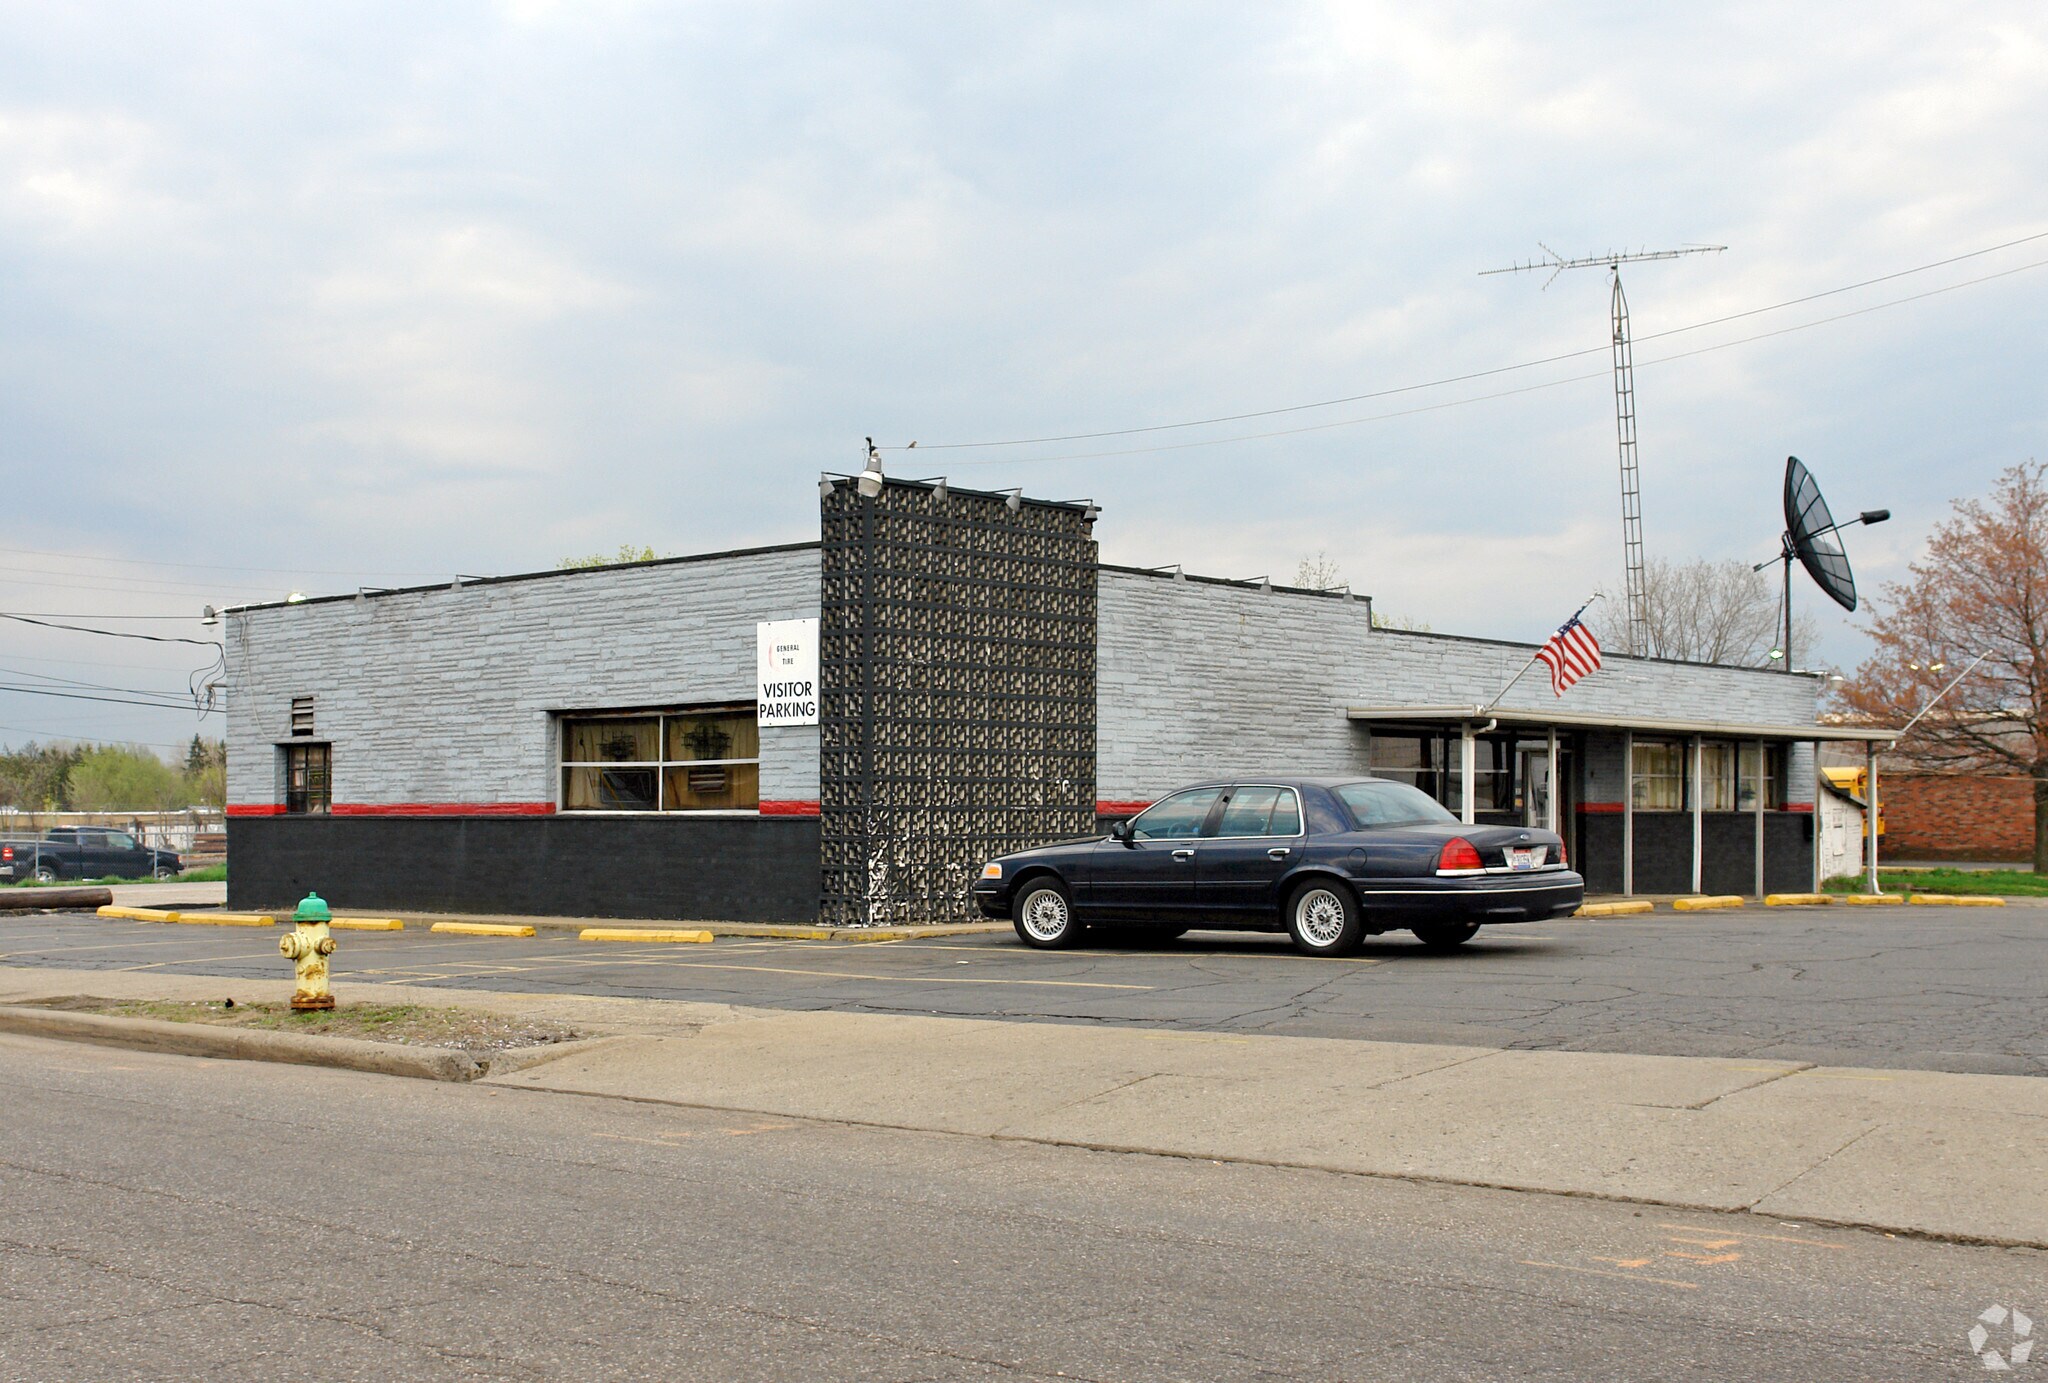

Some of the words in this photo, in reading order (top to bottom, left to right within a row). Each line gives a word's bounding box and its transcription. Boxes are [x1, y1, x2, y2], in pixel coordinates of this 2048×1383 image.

[777, 644, 799, 652] GENERAL
[763, 681, 812, 698] VISITOR
[760, 701, 815, 718] PARKING
